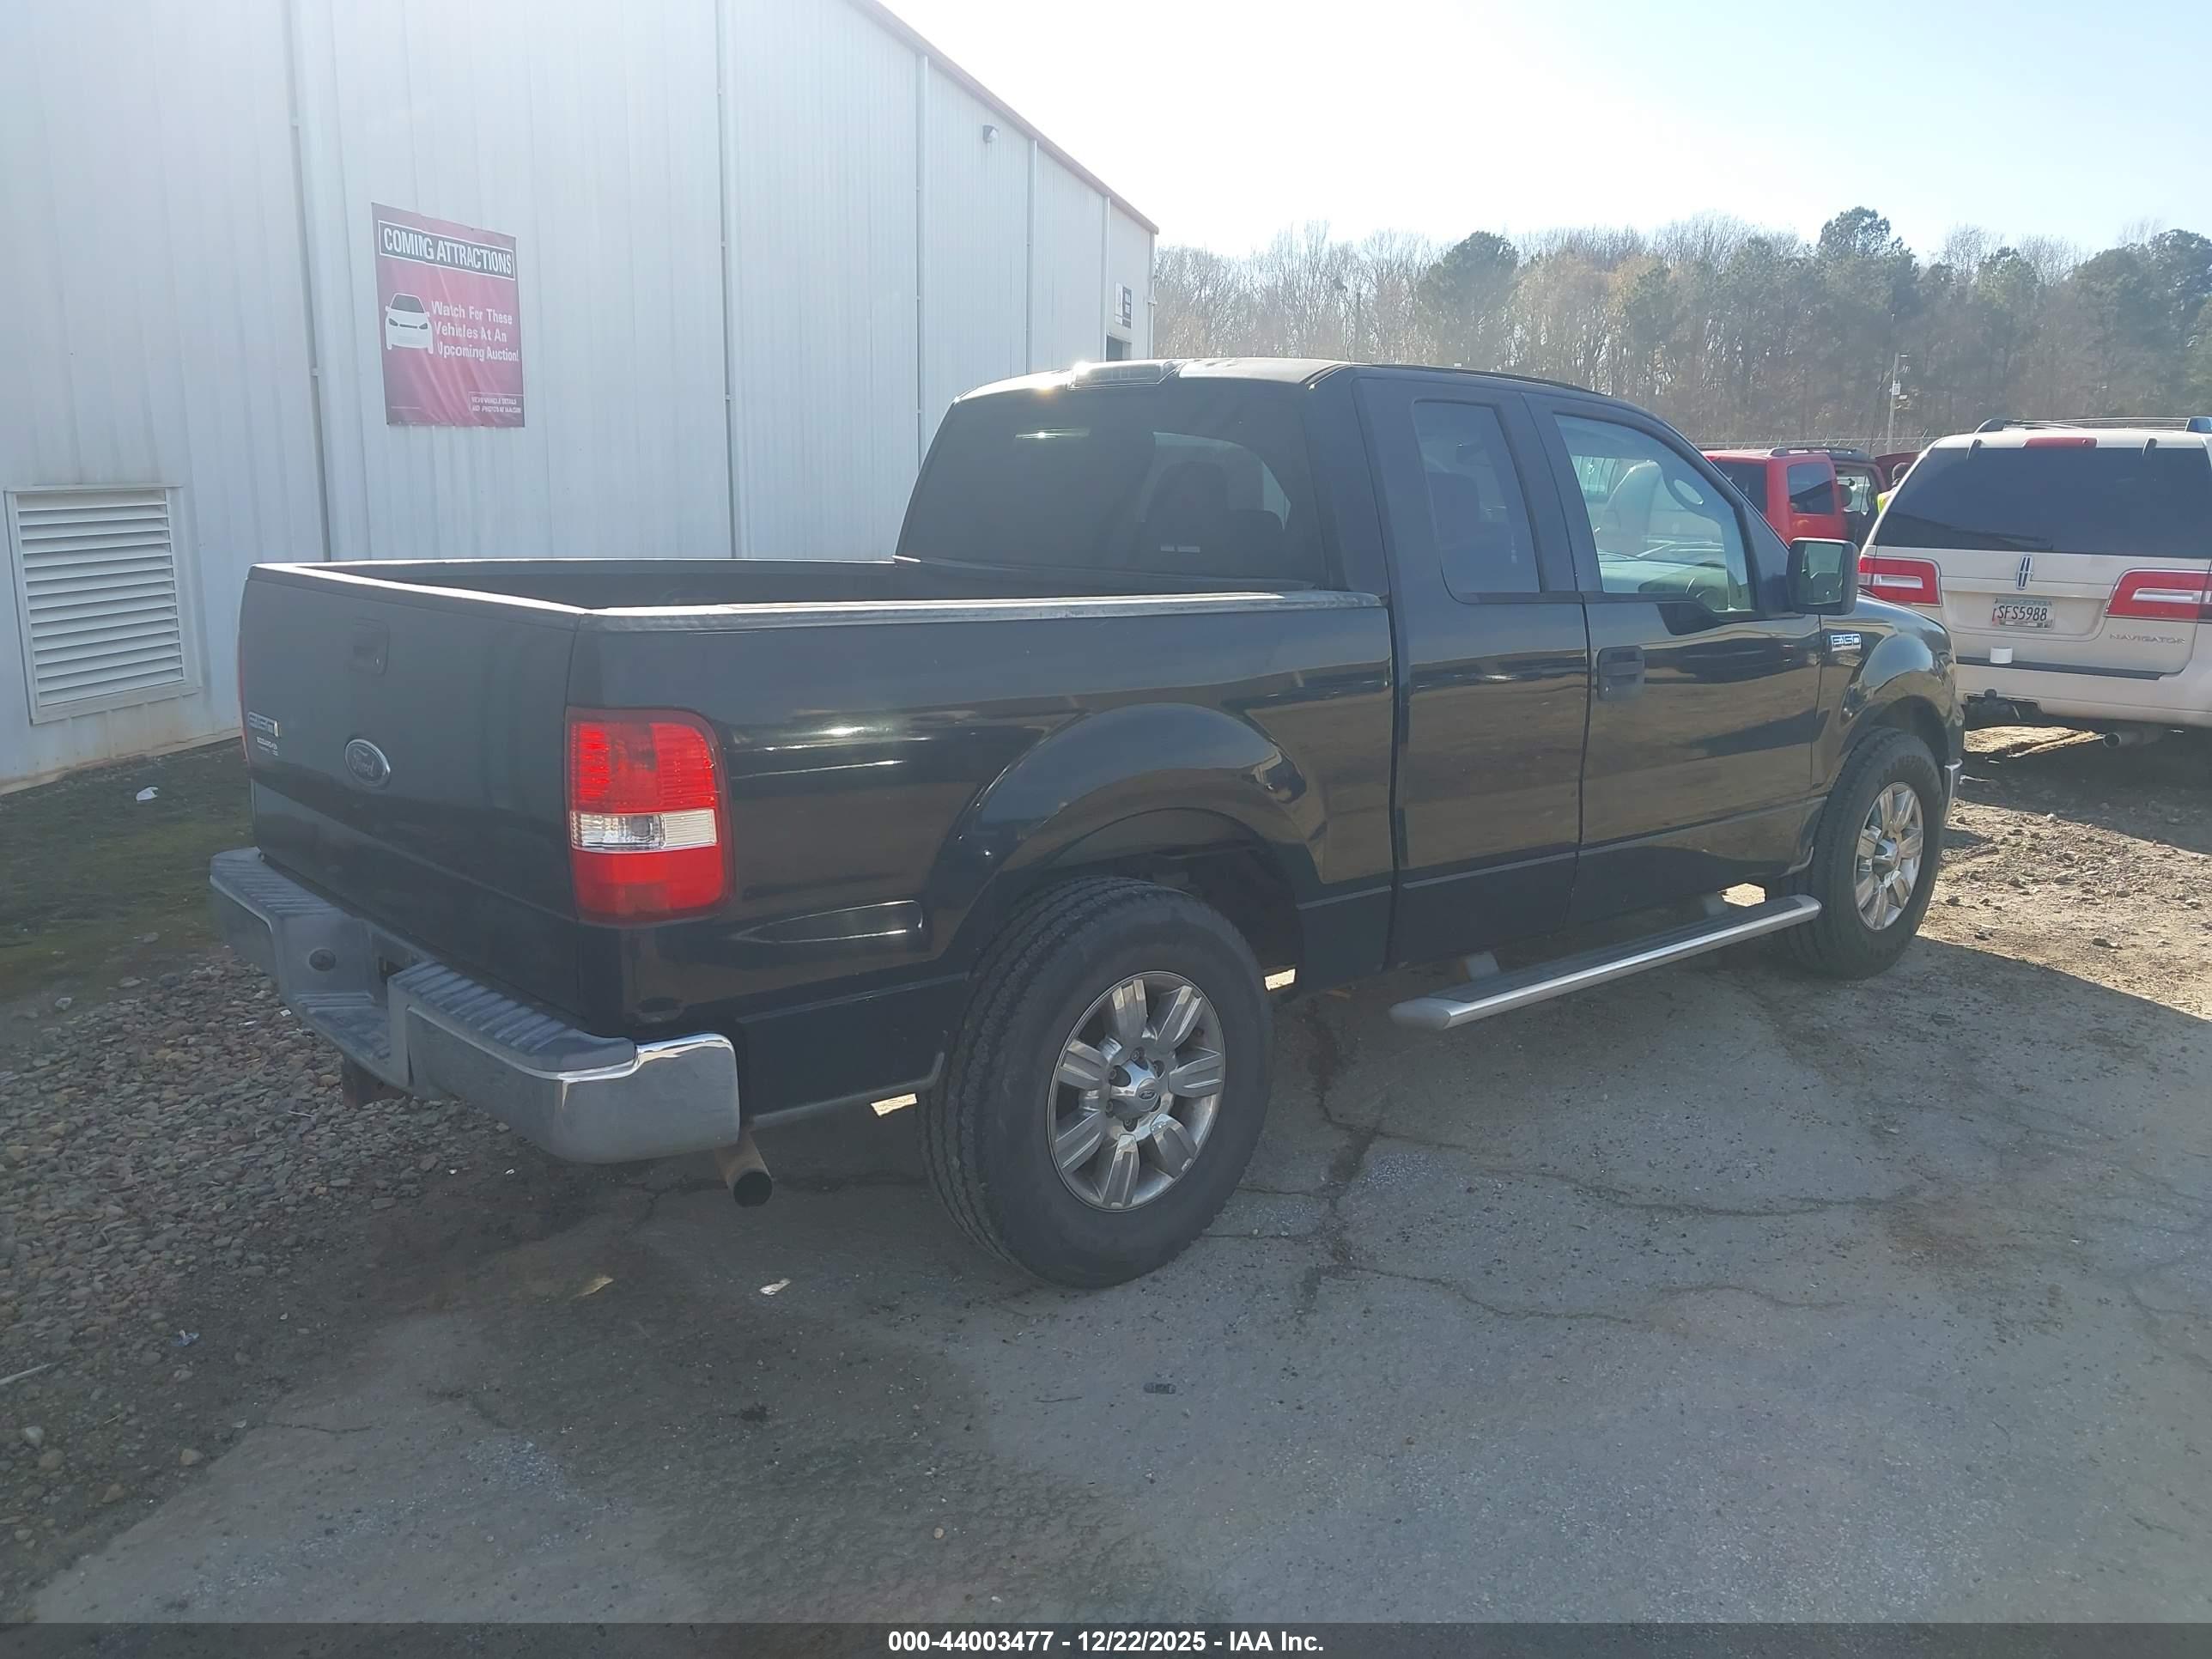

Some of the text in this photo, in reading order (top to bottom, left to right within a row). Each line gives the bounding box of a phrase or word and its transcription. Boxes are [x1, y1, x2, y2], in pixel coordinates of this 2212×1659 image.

[384, 228, 512, 275] COMING ATTRACTIONS
[431, 301, 513, 325] Watch For These
[434, 321, 507, 342] Vehicles At An
[437, 342, 519, 362] Upcoming Auction!
[1997, 605, 2048, 621] SFS5988
[2109, 634, 2185, 645] NAVIGATOR
